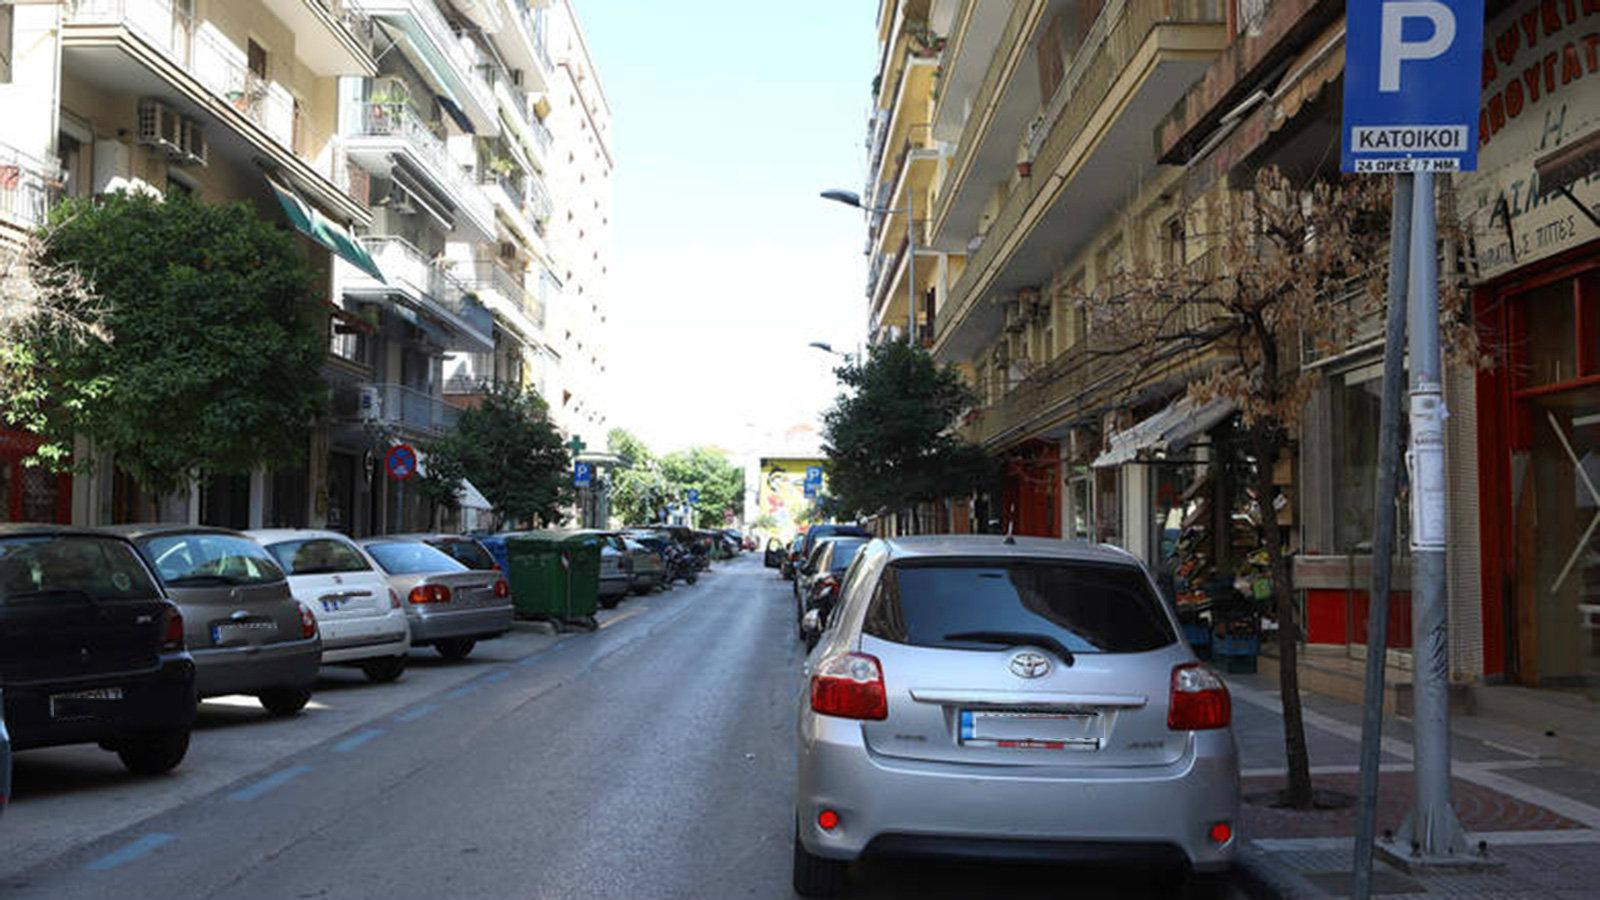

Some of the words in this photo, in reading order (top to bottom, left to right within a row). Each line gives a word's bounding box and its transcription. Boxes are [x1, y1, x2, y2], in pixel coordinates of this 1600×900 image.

[1379, 2, 1456, 92] P
[1360, 129, 1460, 148] ΚΑΤΟΙΚΟΙ
[1358, 160, 1373, 171] 24
[1376, 160, 1411, 171] ΩΡΕΣ
[1422, 160, 1430, 170] 7
